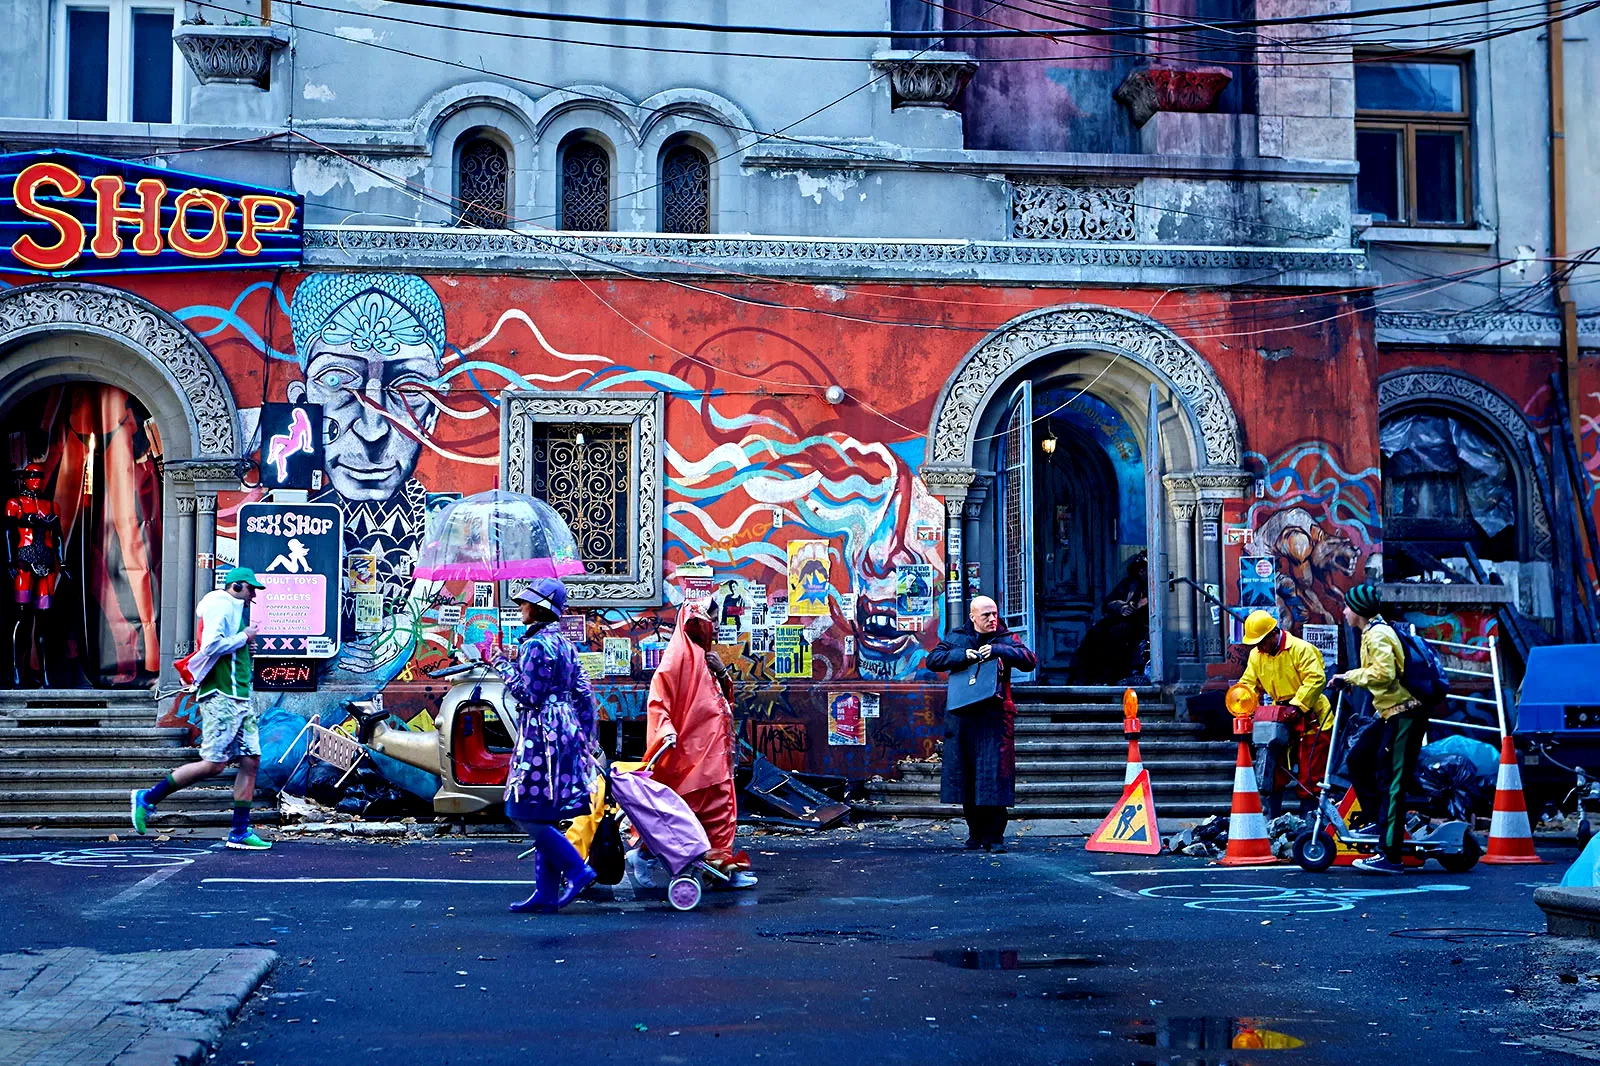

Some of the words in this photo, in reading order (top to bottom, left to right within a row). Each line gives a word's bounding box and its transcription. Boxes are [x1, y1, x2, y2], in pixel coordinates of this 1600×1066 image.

[11, 162, 296, 269] SHOP
[246, 514, 282, 536] SEX
[282, 512, 333, 537] SHOP
[260, 577, 290, 585] ADULT
[293, 577, 318, 585] TOYS
[266, 593, 311, 601] GADGETS
[685, 587, 711, 599] flakes
[261, 667, 310, 681] OPEN
